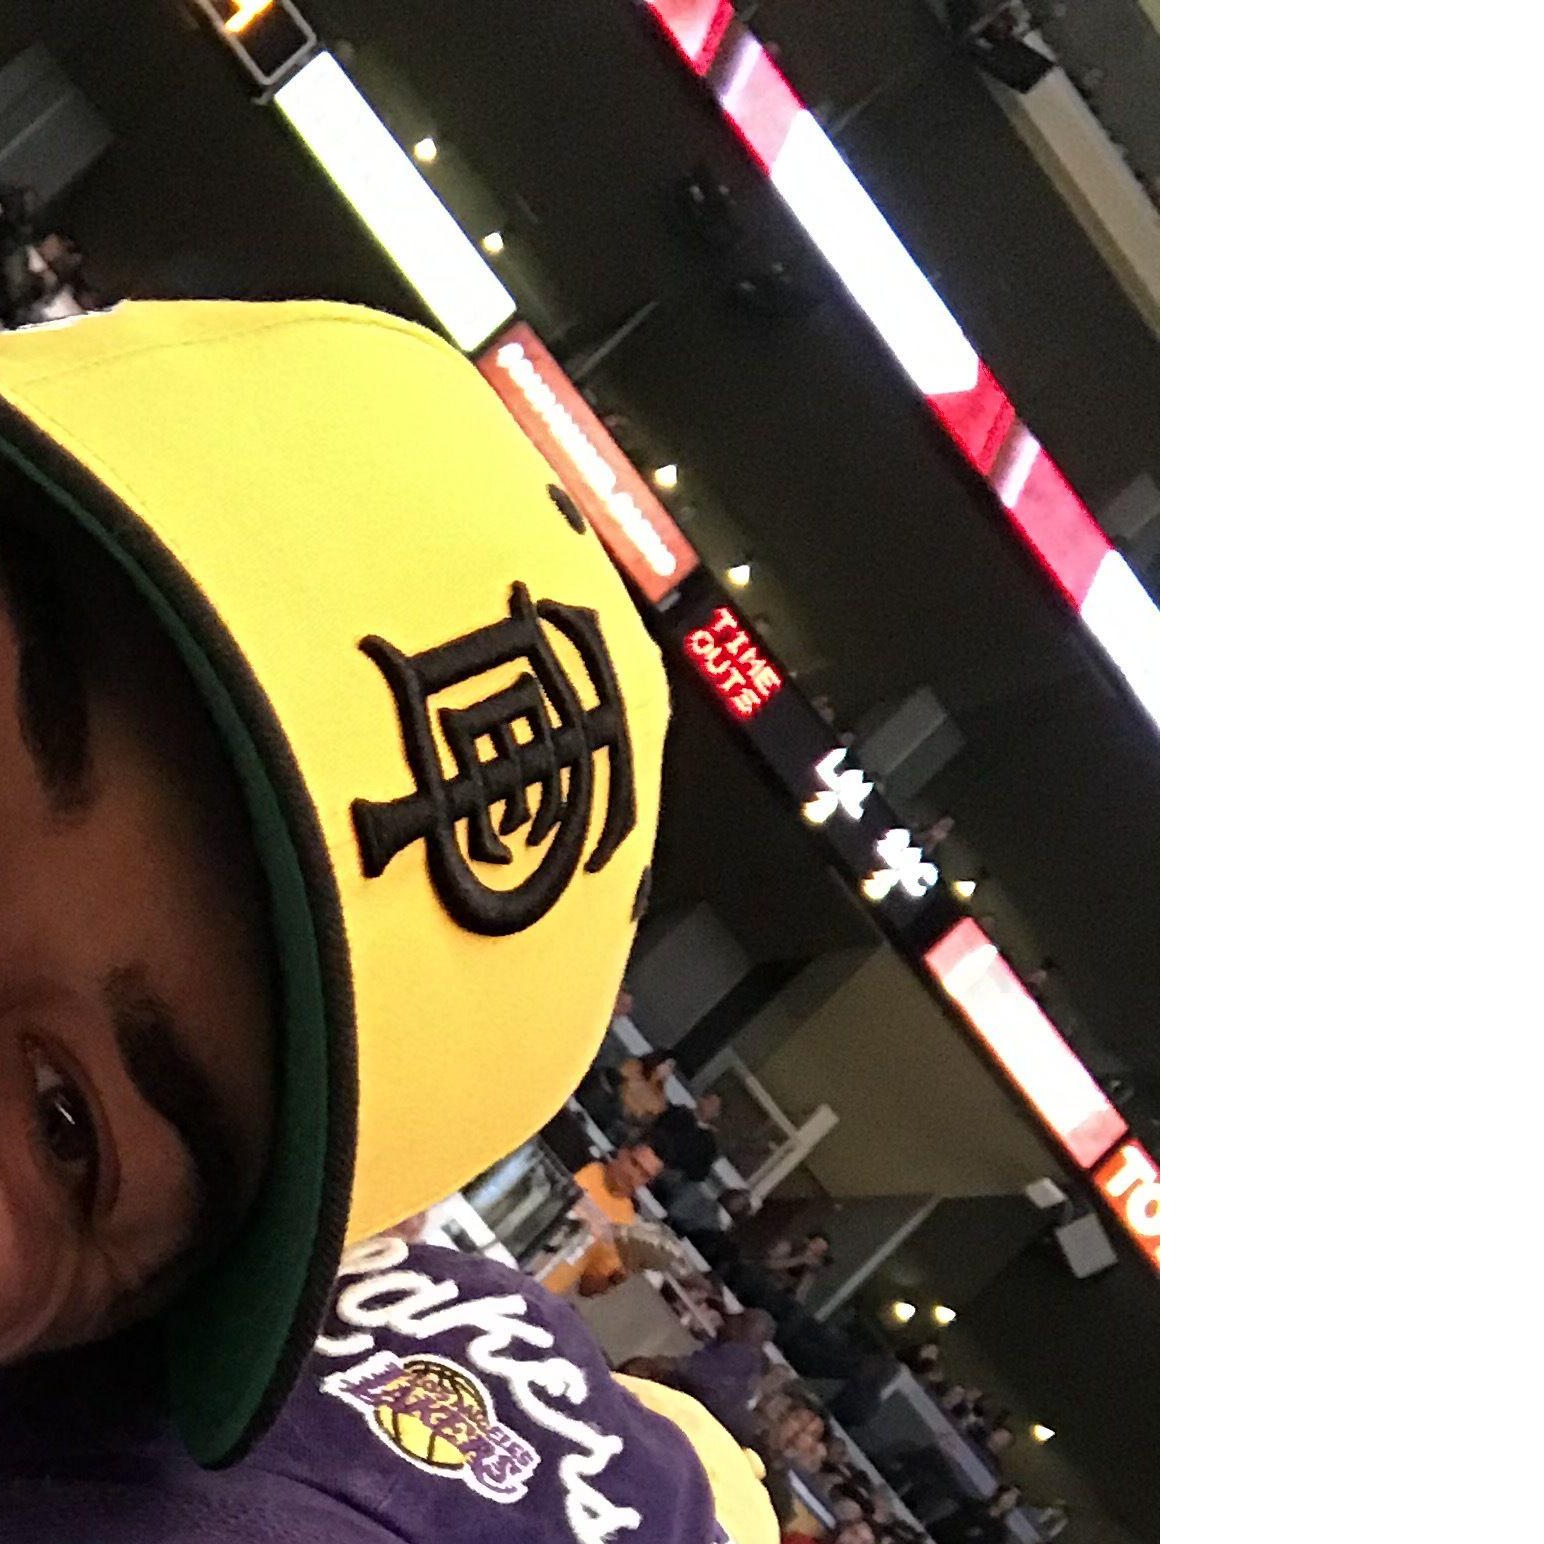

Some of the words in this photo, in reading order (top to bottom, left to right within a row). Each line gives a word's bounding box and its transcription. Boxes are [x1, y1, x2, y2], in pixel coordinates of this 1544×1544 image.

[687, 628, 762, 714] OUTS
[711, 606, 783, 697] TIME
[1104, 1144, 1160, 1260] TO
[338, 1362, 524, 1494] LAKERS
